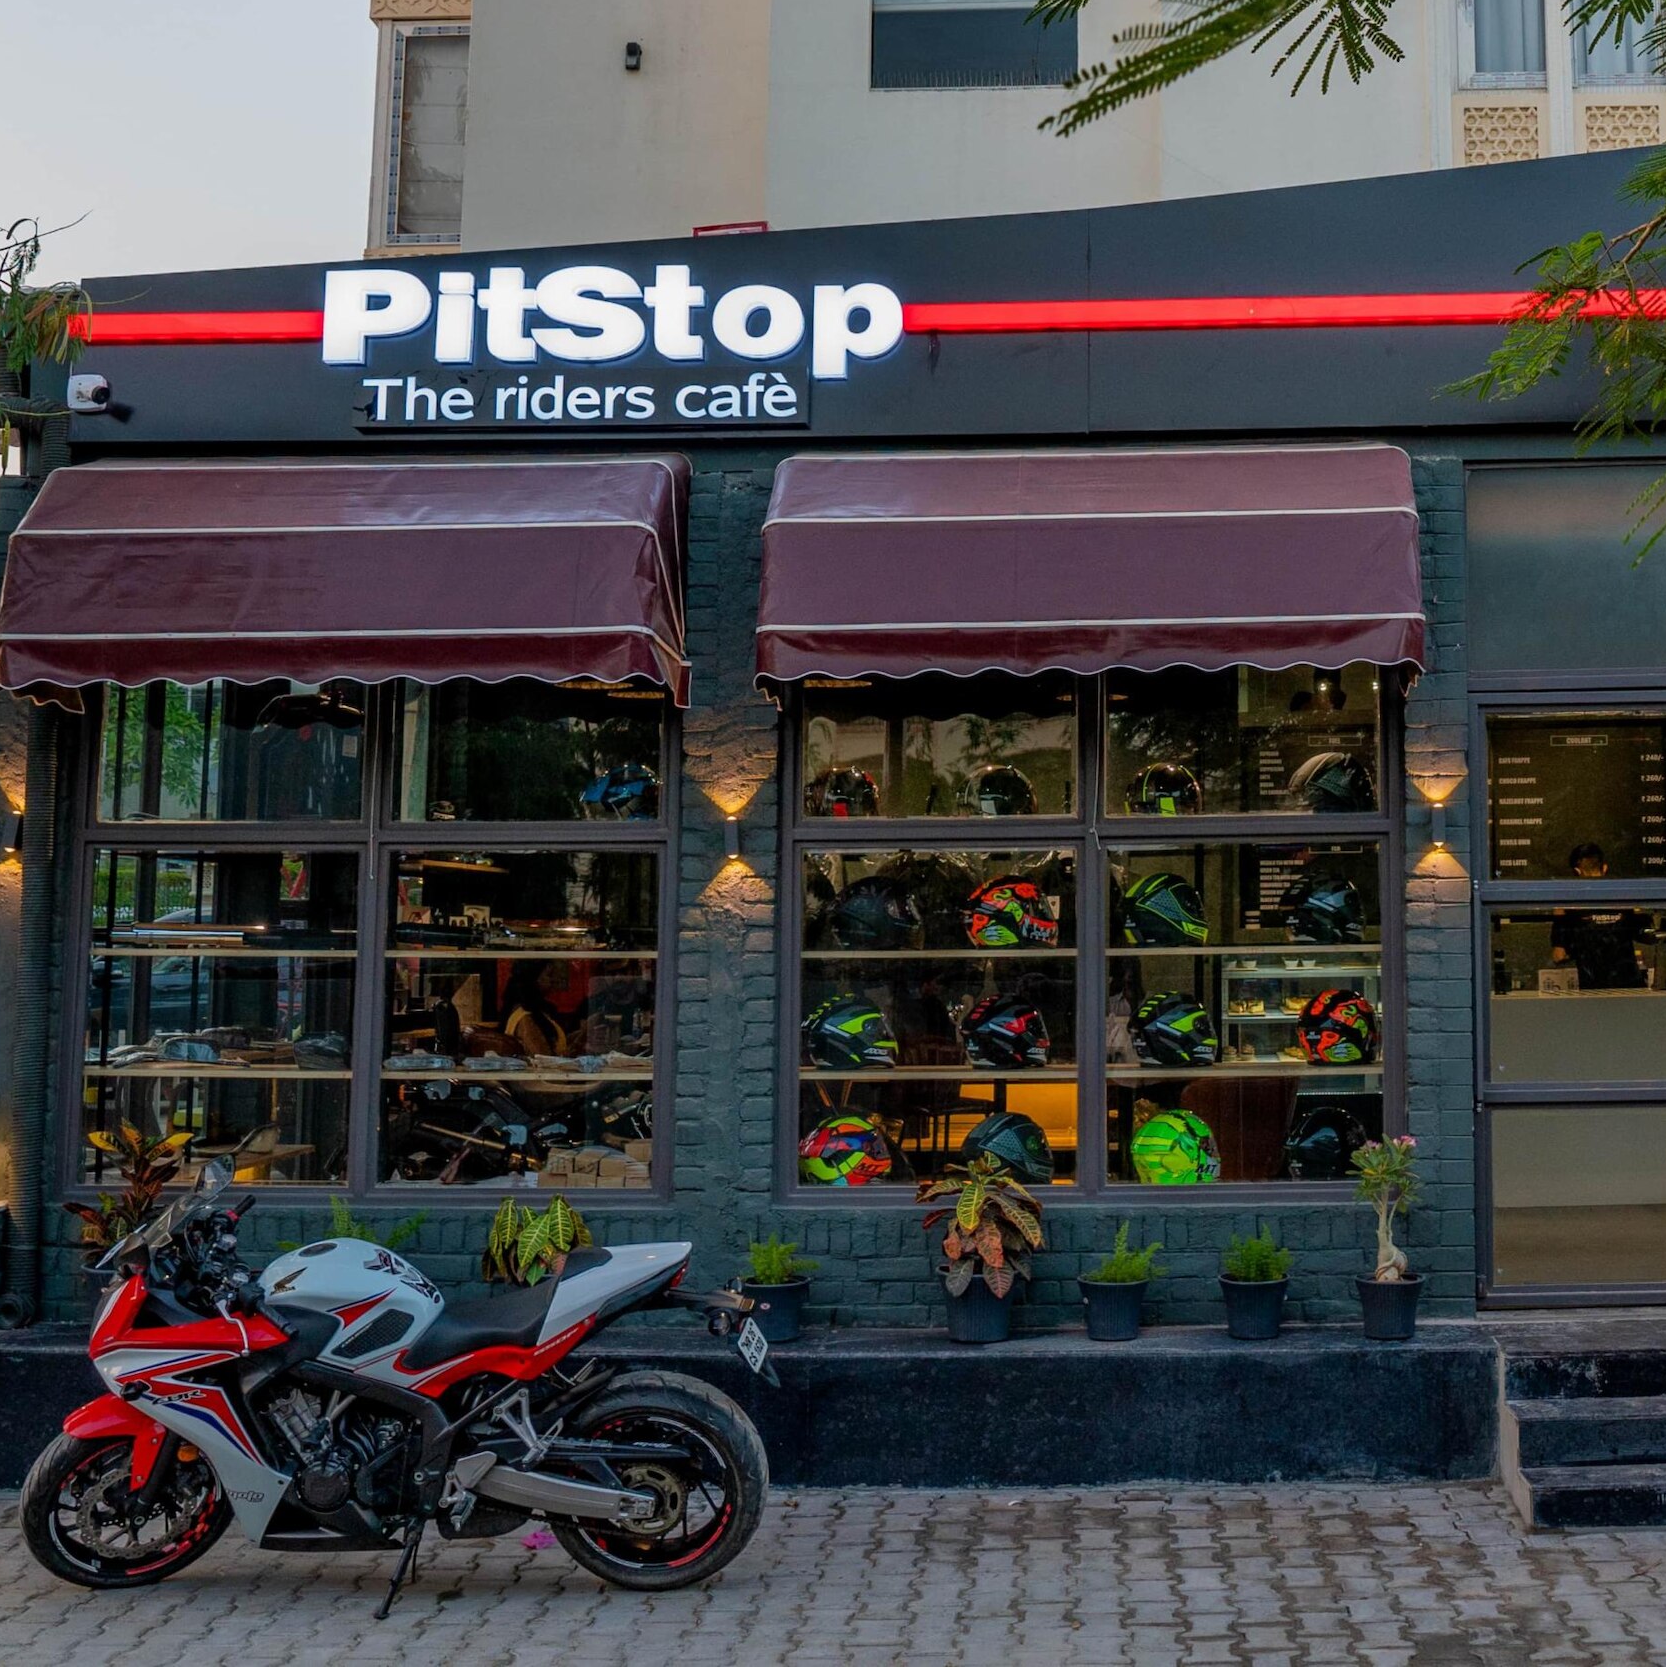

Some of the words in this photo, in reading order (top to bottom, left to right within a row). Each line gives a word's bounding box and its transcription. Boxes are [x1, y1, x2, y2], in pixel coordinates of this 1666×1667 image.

[323, 264, 904, 380] PitStop
[362, 377, 474, 421] The
[495, 375, 656, 421] riders
[675, 372, 798, 419] cafè
